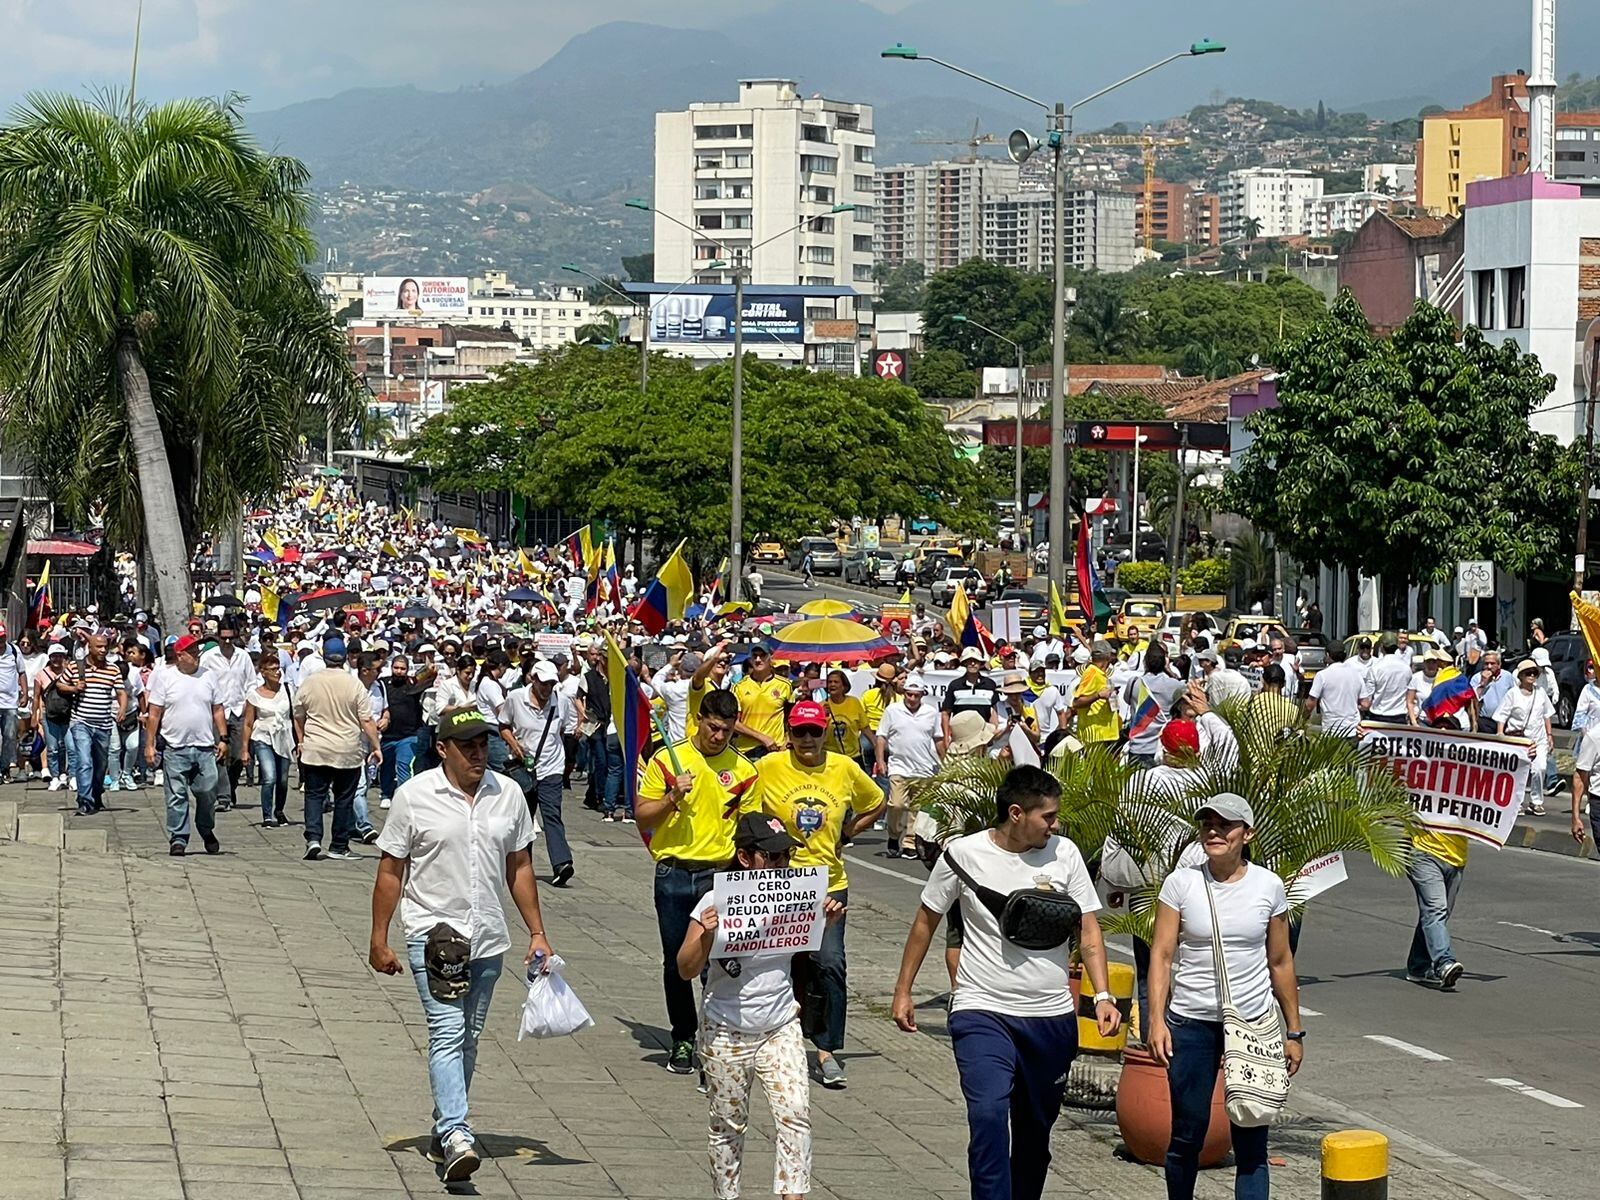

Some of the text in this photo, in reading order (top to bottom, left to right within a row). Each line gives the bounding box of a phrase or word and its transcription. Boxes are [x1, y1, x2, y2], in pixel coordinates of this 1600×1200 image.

[422, 286, 466, 294] AUTORIDAD
[741, 309, 788, 318] CONTROL
[750, 303, 781, 311] TOTAL
[1371, 736, 1520, 773] ESTE ES UN GOBIERNO
[781, 783, 813, 804] LIBERTAD
[1437, 797, 1504, 829] PETRO!
[726, 867, 818, 882] #SI MATRICULA
[757, 881, 791, 892] CERO
[727, 890, 817, 906] #SI CONDONAR
[727, 902, 815, 917] DEUDA ICETEX
[723, 918, 743, 929] NO
[747, 917, 757, 928] A
[761, 916, 767, 927] 1
[728, 923, 810, 942] PARA 100.000
[724, 936, 809, 953] PANDILLEROS
